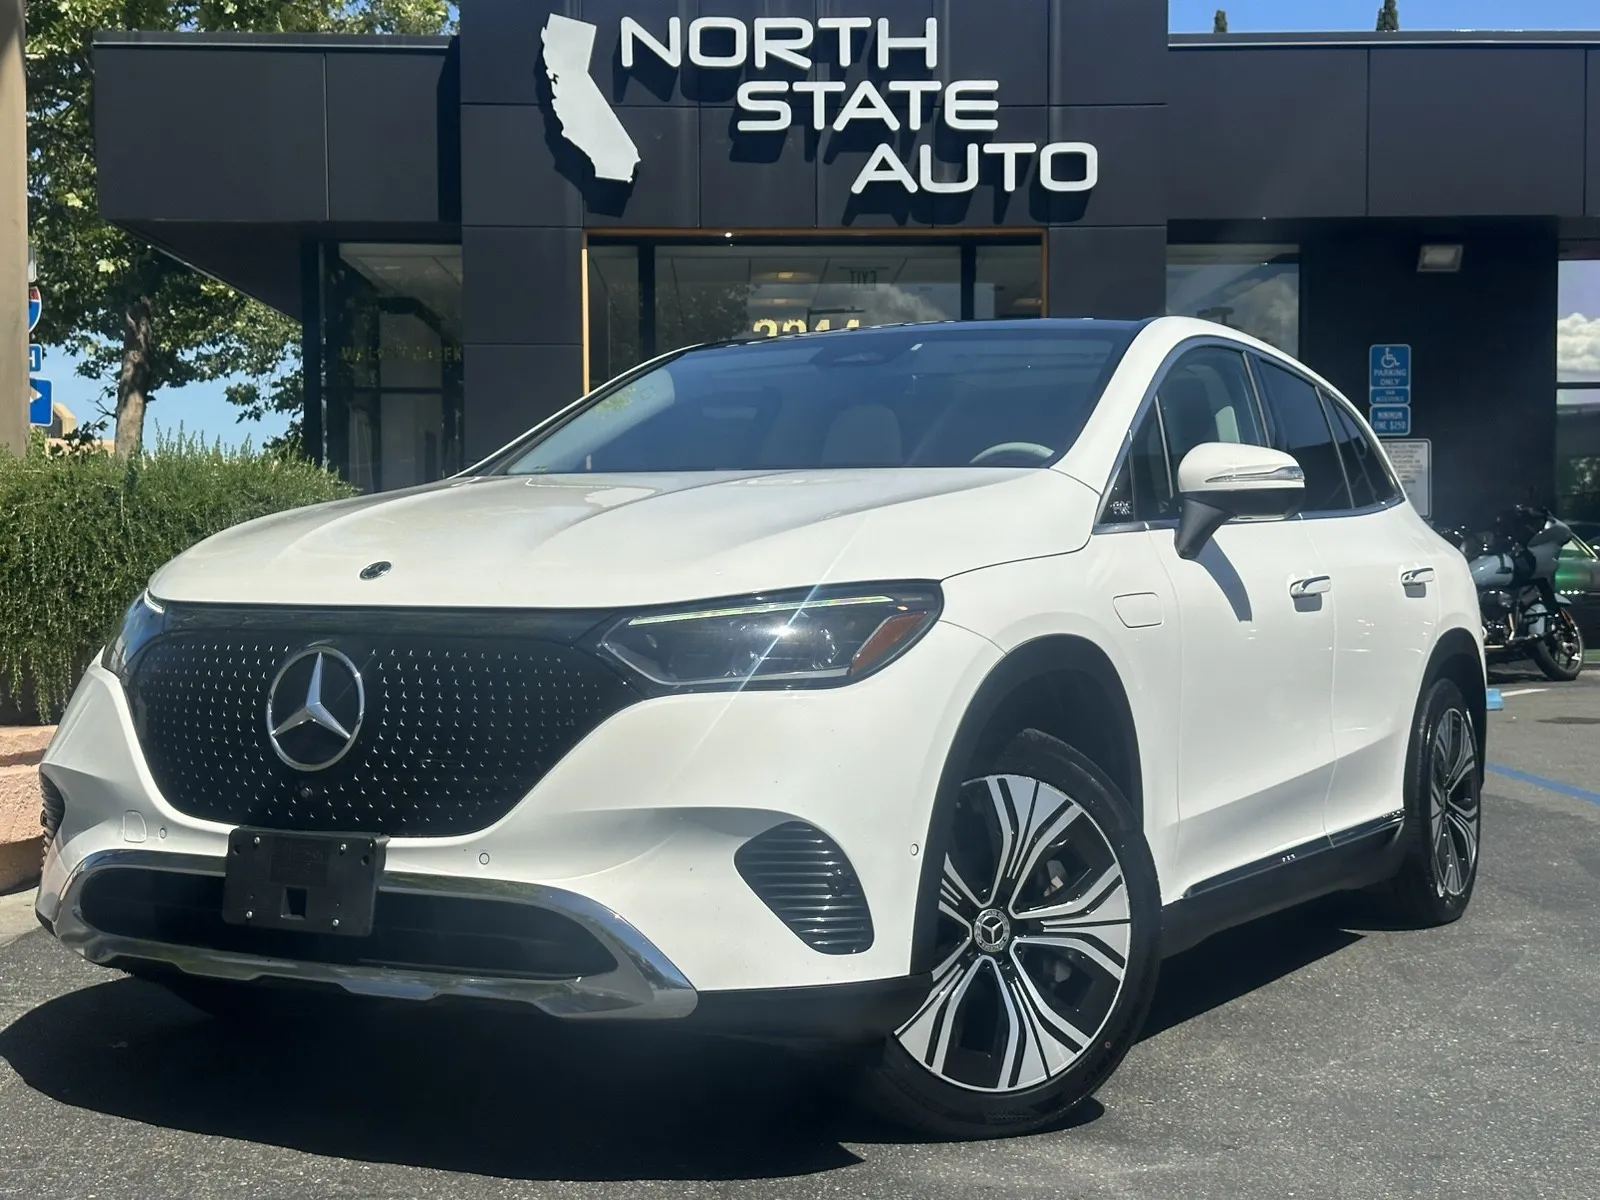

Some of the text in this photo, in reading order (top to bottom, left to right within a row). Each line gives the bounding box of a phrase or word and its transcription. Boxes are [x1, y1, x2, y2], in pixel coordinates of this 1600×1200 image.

[620, 16, 938, 69] NORTH
[736, 80, 999, 131] STATE
[850, 142, 1099, 194] AUTO
[1373, 368, 1407, 377] PARKING
[1379, 378, 1400, 386] ONLY
[1389, 420, 1407, 430] $250
